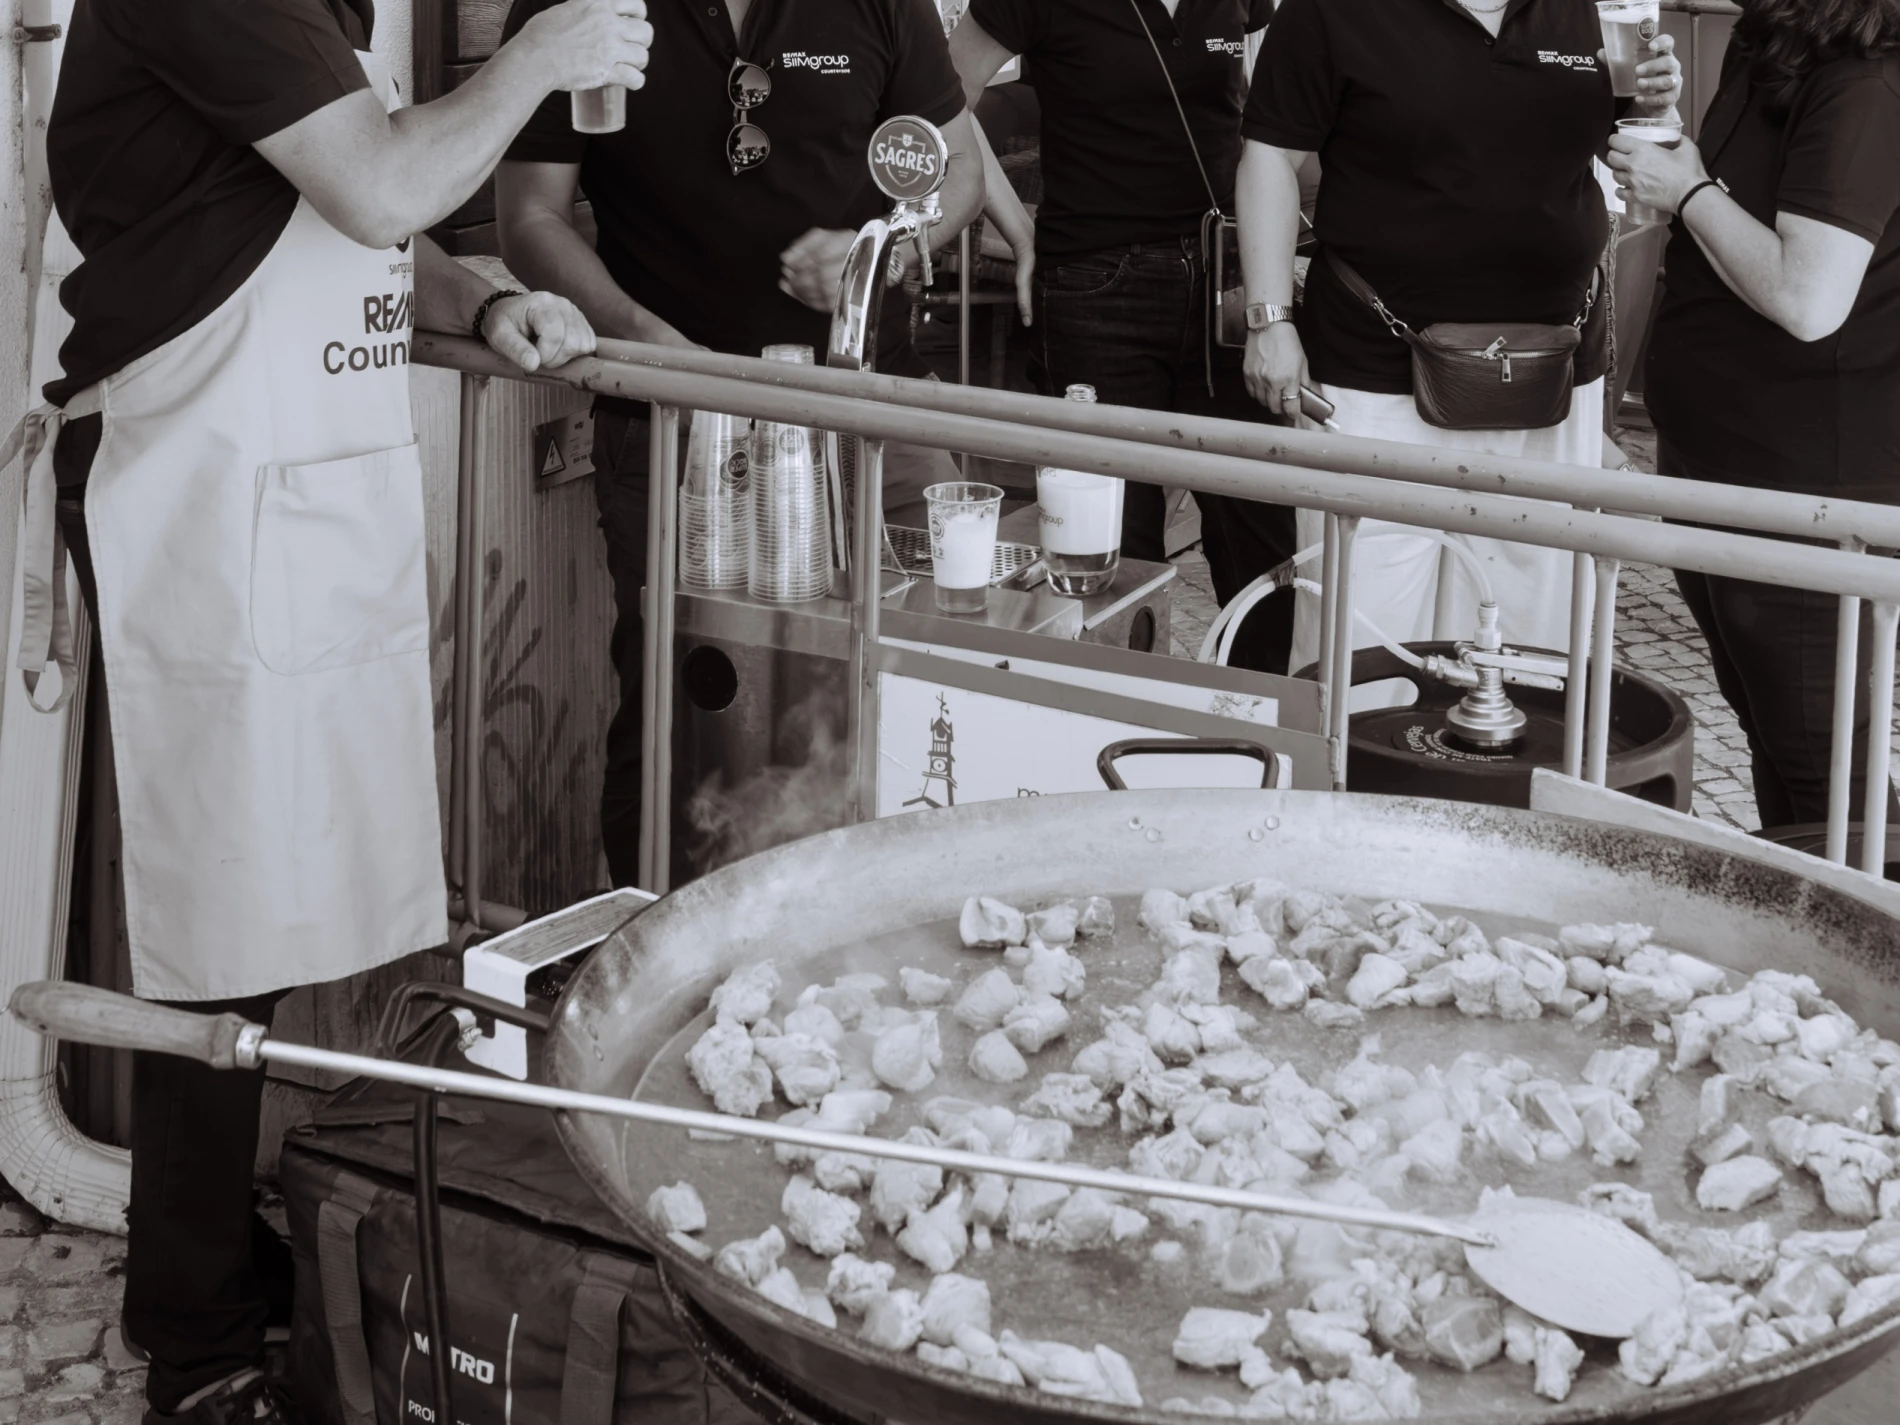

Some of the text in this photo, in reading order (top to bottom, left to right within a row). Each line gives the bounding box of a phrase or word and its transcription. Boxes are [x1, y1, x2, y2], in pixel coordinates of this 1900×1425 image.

[874, 142, 936, 176] SAGRES
[323, 338, 411, 375] Coun
[413, 1331, 495, 1384] MTRO
